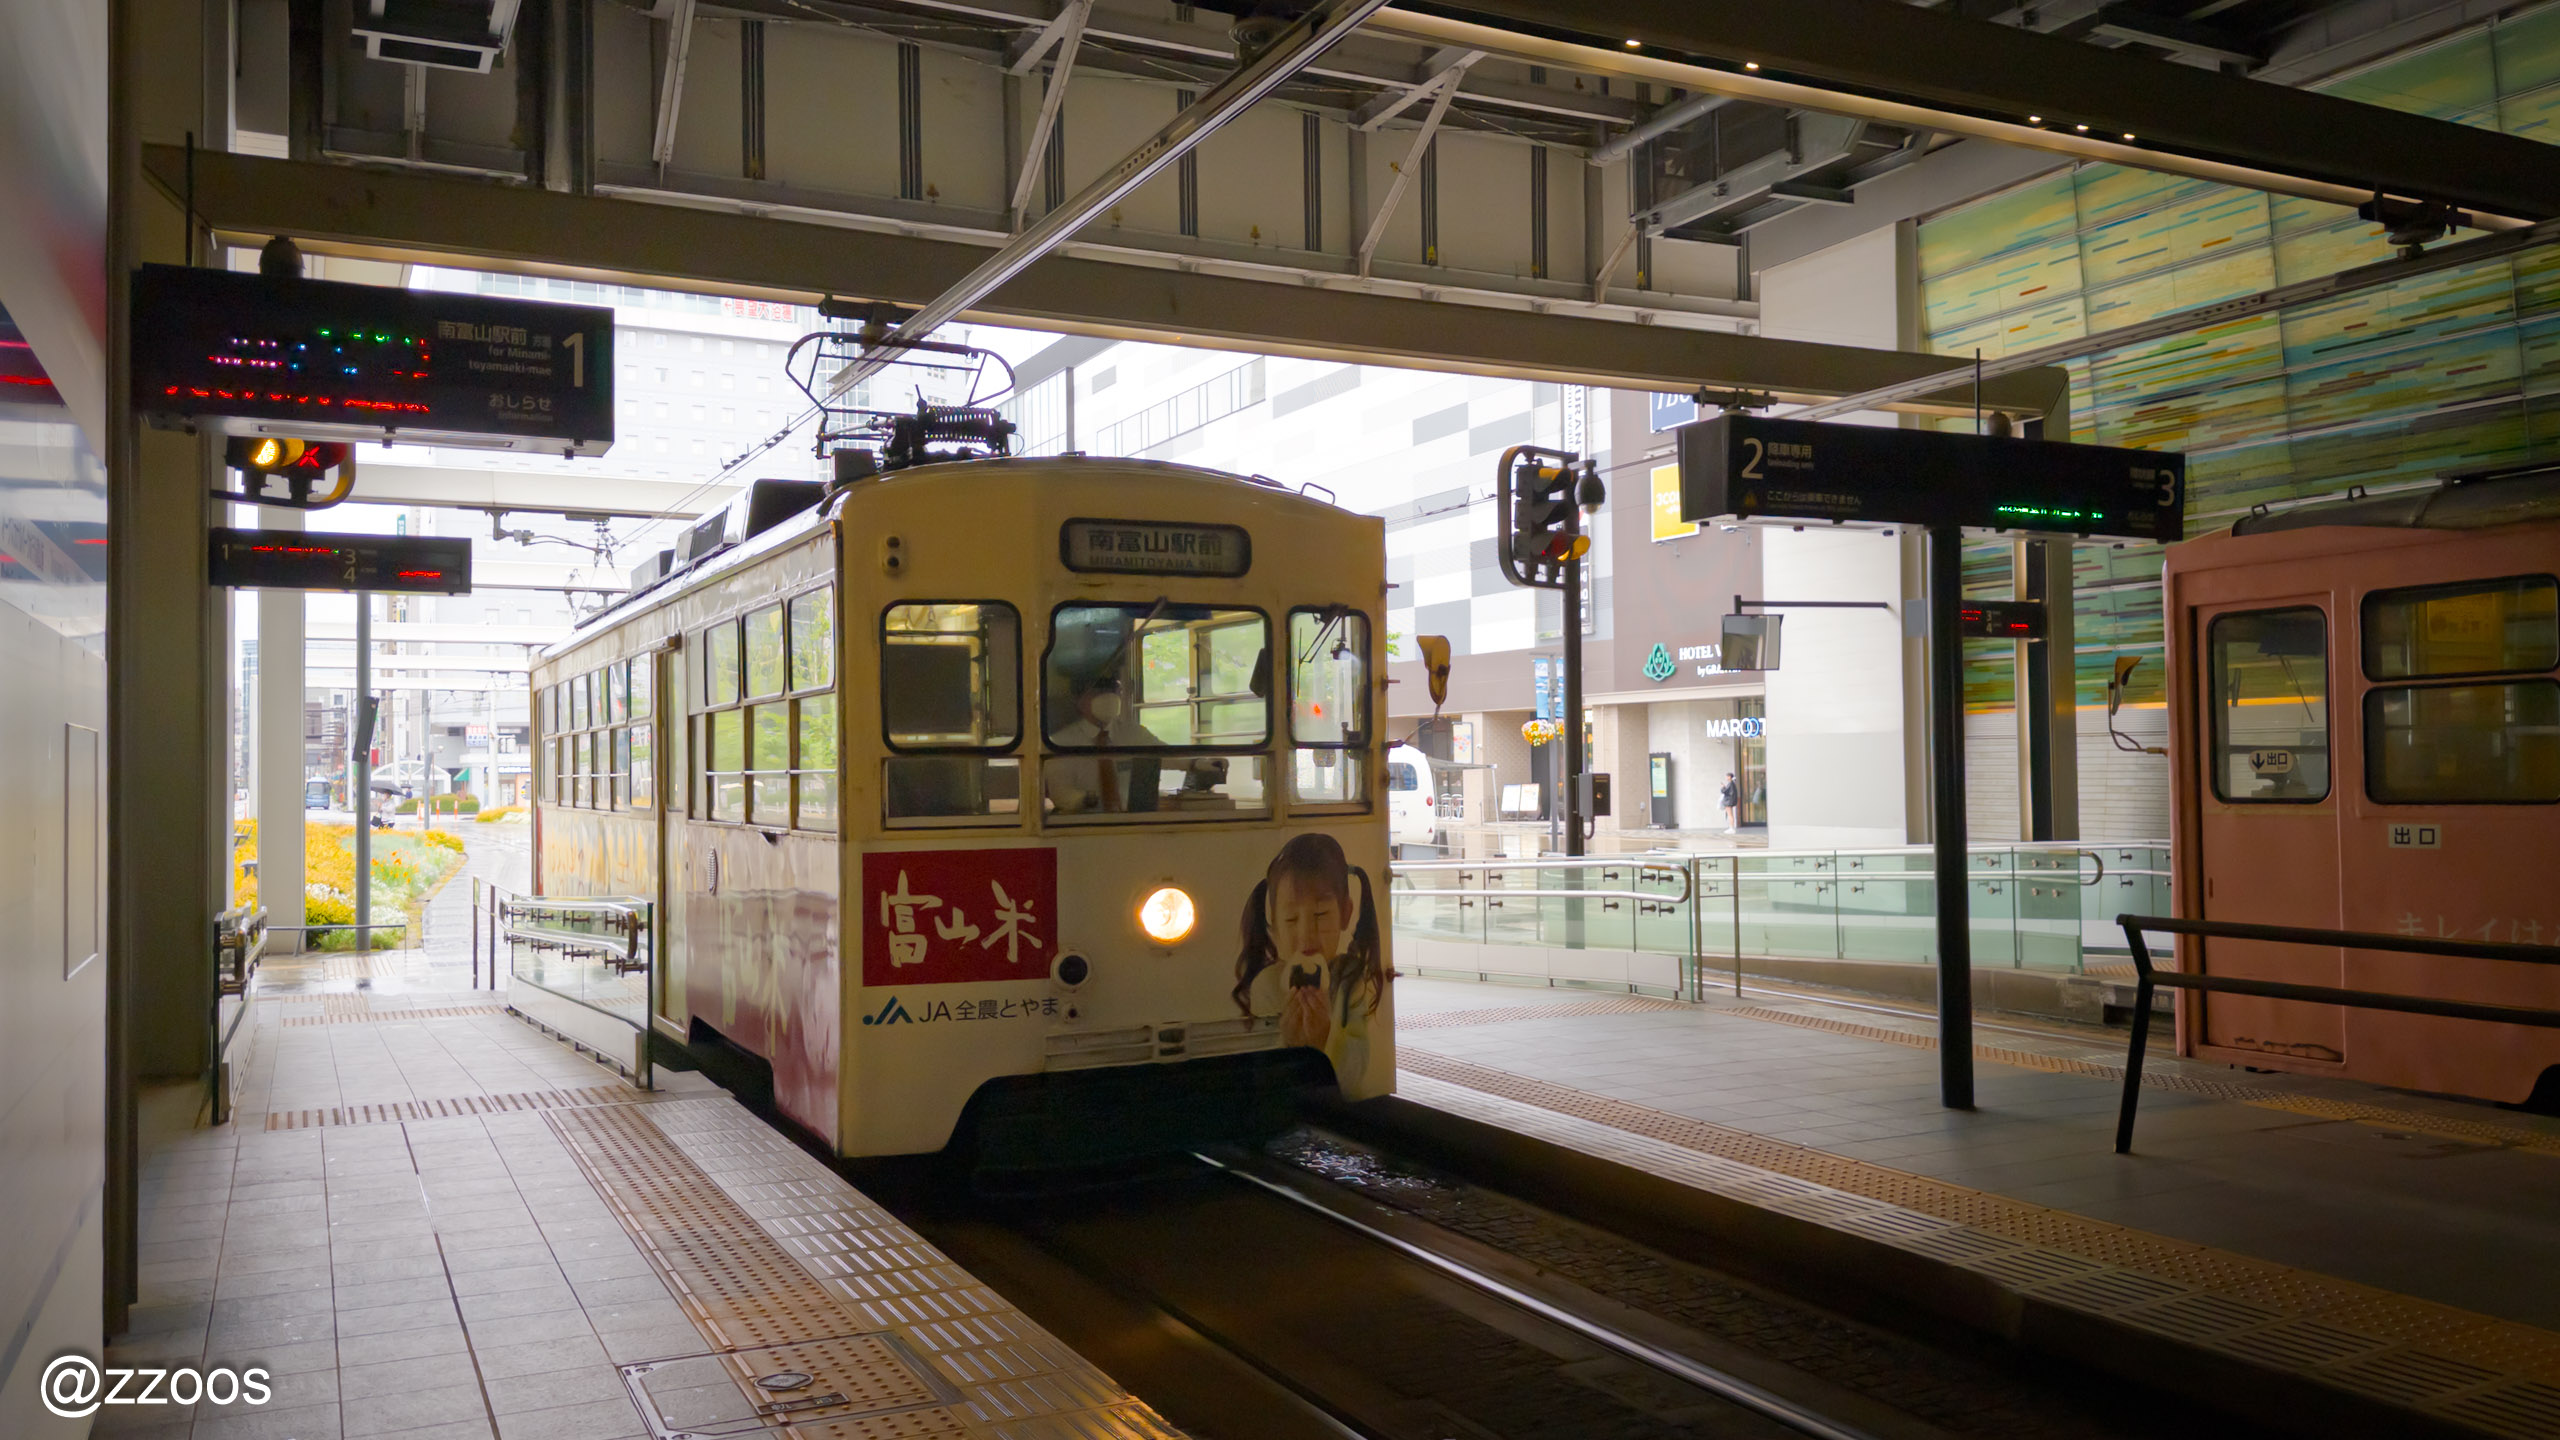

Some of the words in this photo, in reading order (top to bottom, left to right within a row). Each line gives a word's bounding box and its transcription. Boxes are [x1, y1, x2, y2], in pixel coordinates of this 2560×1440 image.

[437, 321, 528, 346] 南富山駅前
[562, 332, 585, 388] 1
[489, 393, 553, 412] おしらせ
[1741, 437, 1764, 480] 2
[2158, 469, 2176, 507] 3
[221, 543, 230, 561] 1
[1088, 529, 1222, 556] 南富山駅前
[344, 548, 357, 565] 3
[343, 566, 357, 583] 4
[1679, 645, 1713, 660] HOTEL
[2267, 752, 2288, 766] 出口
[2394, 827, 2435, 845] 出口
[880, 869, 1043, 968] 富山米
